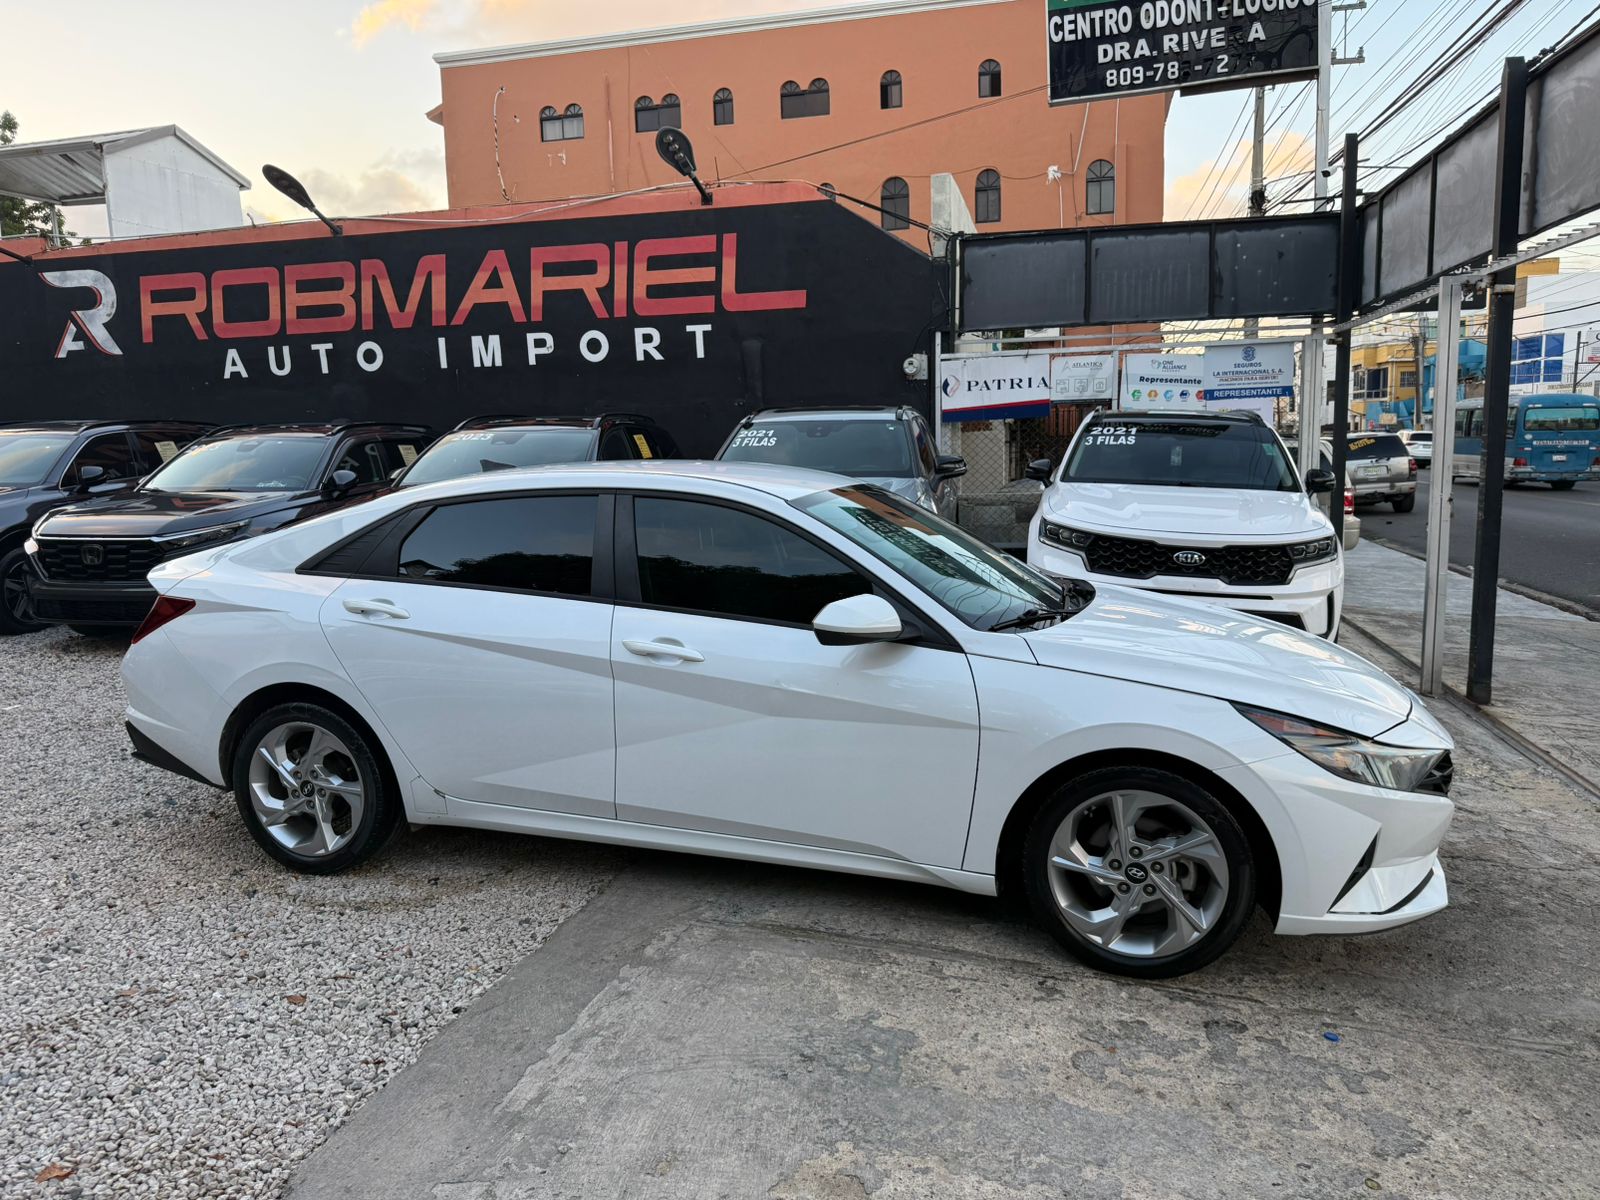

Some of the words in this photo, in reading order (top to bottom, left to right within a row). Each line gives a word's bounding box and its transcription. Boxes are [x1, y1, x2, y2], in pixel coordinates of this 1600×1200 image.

[1049, 5, 1133, 43] CENTRO
[1097, 38, 1158, 64] DRA.
[1163, 21, 1266, 54] RIVEA
[139, 232, 807, 343] ROBMARIEL
[223, 341, 384, 379] AUTO
[437, 324, 713, 369] IMPORT
[967, 376, 1052, 392] PATRIA
[1139, 375, 1202, 385] Representante
[1213, 388, 1283, 398] REPRESENTANTE
[737, 429, 775, 438] 2021
[1090, 426, 1137, 435] 2021
[732, 438, 741, 448] 3
[742, 437, 778, 447] FILAS
[1084, 436, 1094, 446] 3
[1096, 435, 1136, 445] FILAS
[1179, 553, 1200, 563] KIA
